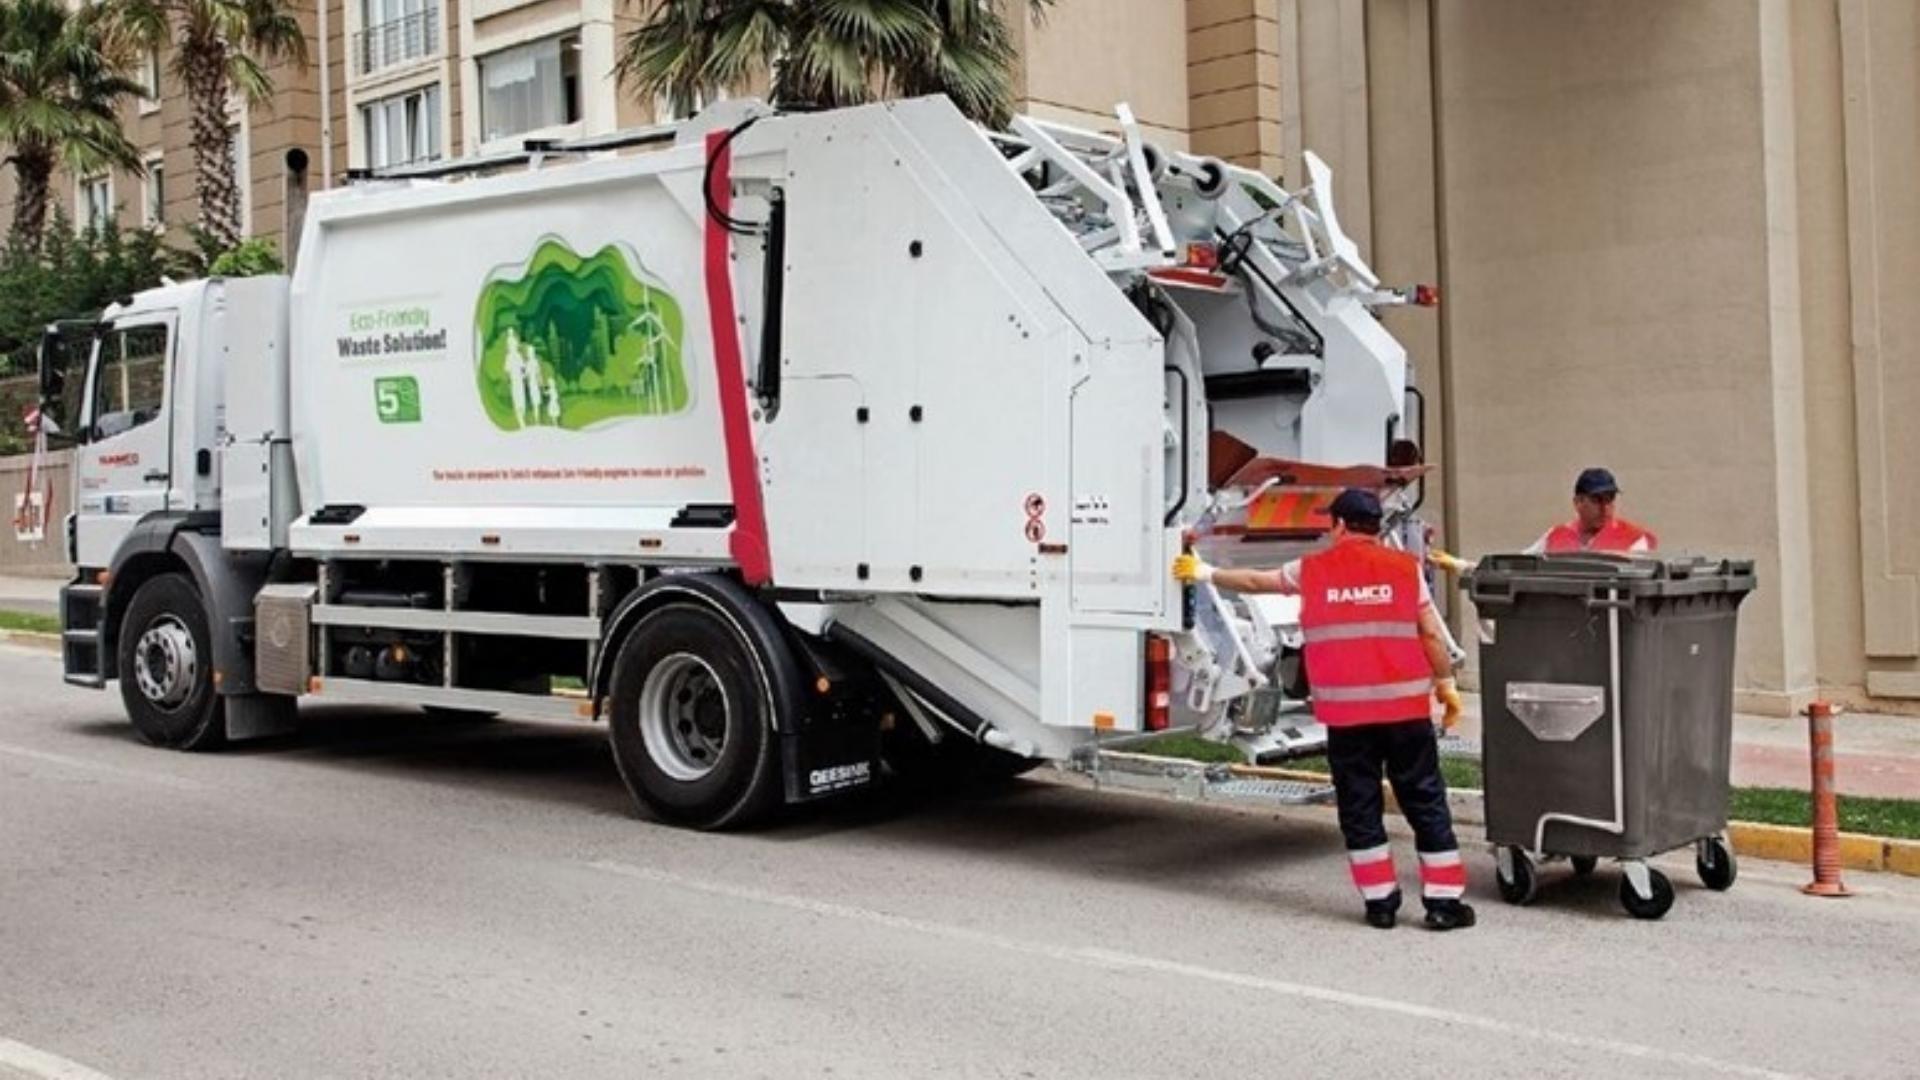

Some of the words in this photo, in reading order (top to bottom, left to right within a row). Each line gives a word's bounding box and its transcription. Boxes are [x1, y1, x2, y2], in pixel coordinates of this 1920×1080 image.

[350, 306, 429, 331] Eco-Friendly
[336, 336, 380, 357] Waste
[383, 328, 447, 353] Solution!
[379, 387, 401, 414] 5
[1327, 584, 1393, 603] RAMCO
